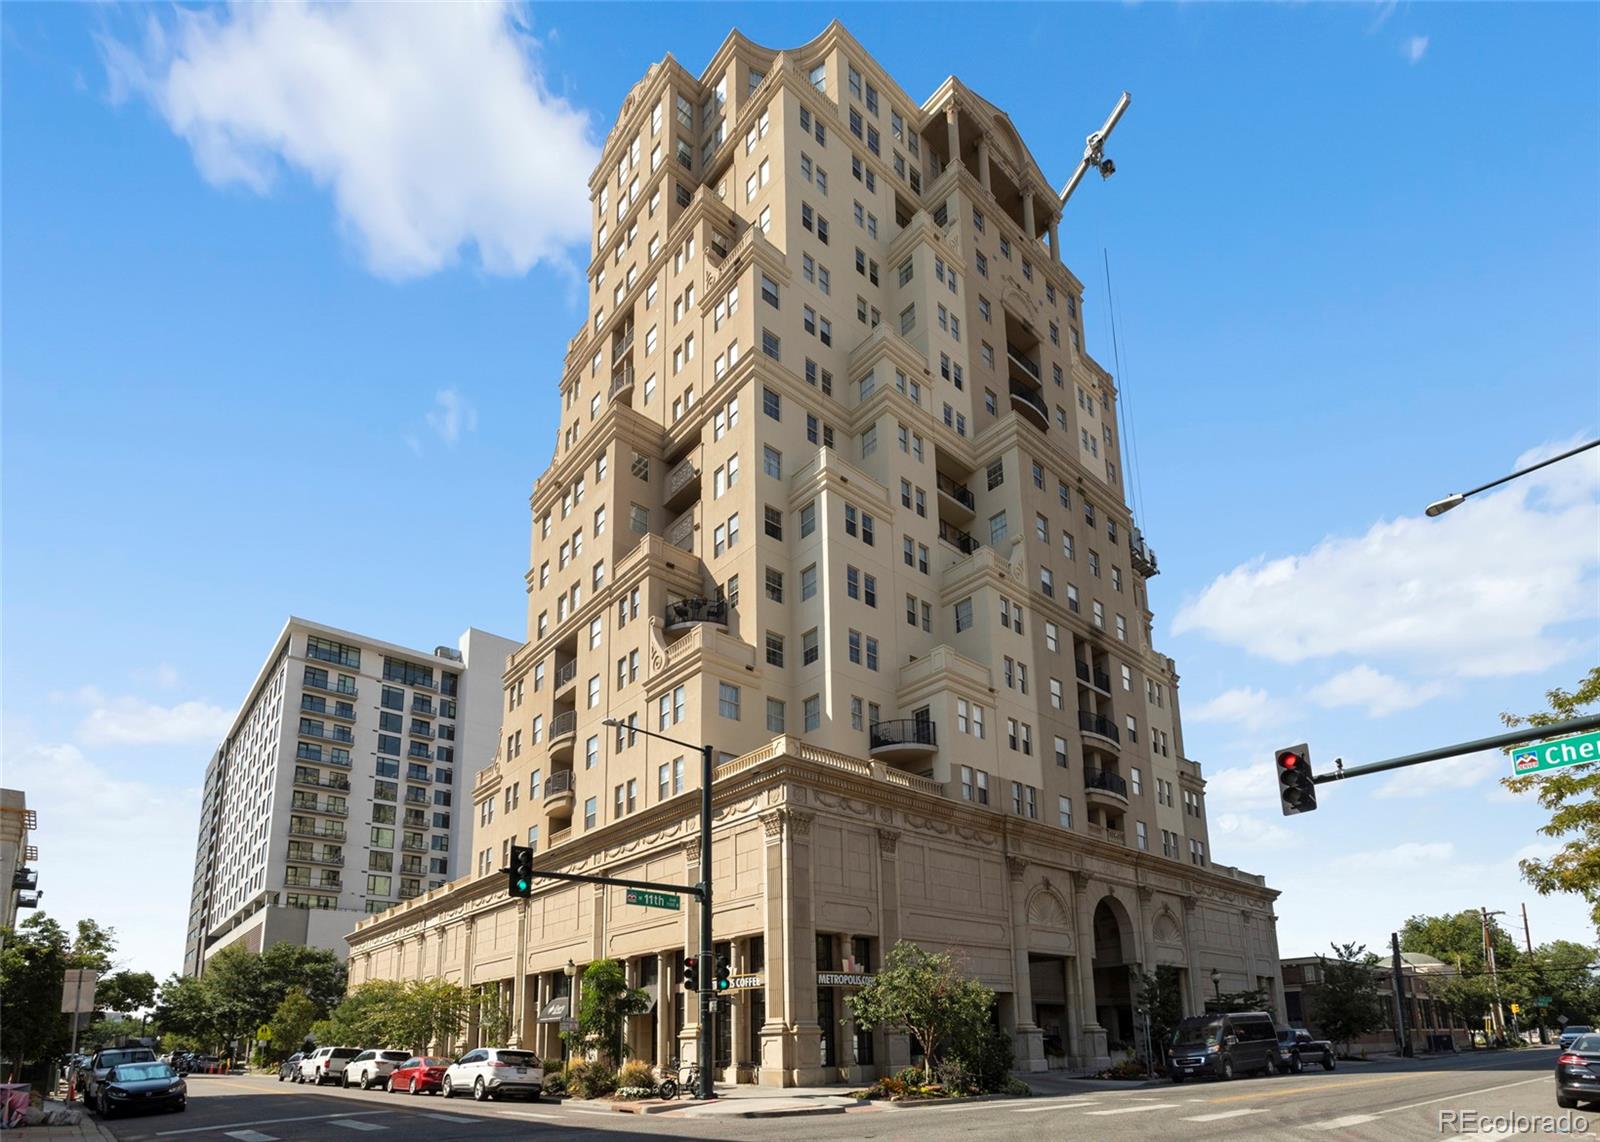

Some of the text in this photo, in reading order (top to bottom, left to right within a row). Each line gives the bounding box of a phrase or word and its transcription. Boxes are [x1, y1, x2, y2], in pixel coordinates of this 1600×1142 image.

[644, 894, 665, 907] 11th
[735, 976, 761, 988] COFFEE
[818, 974, 861, 985] METROPOLIS
